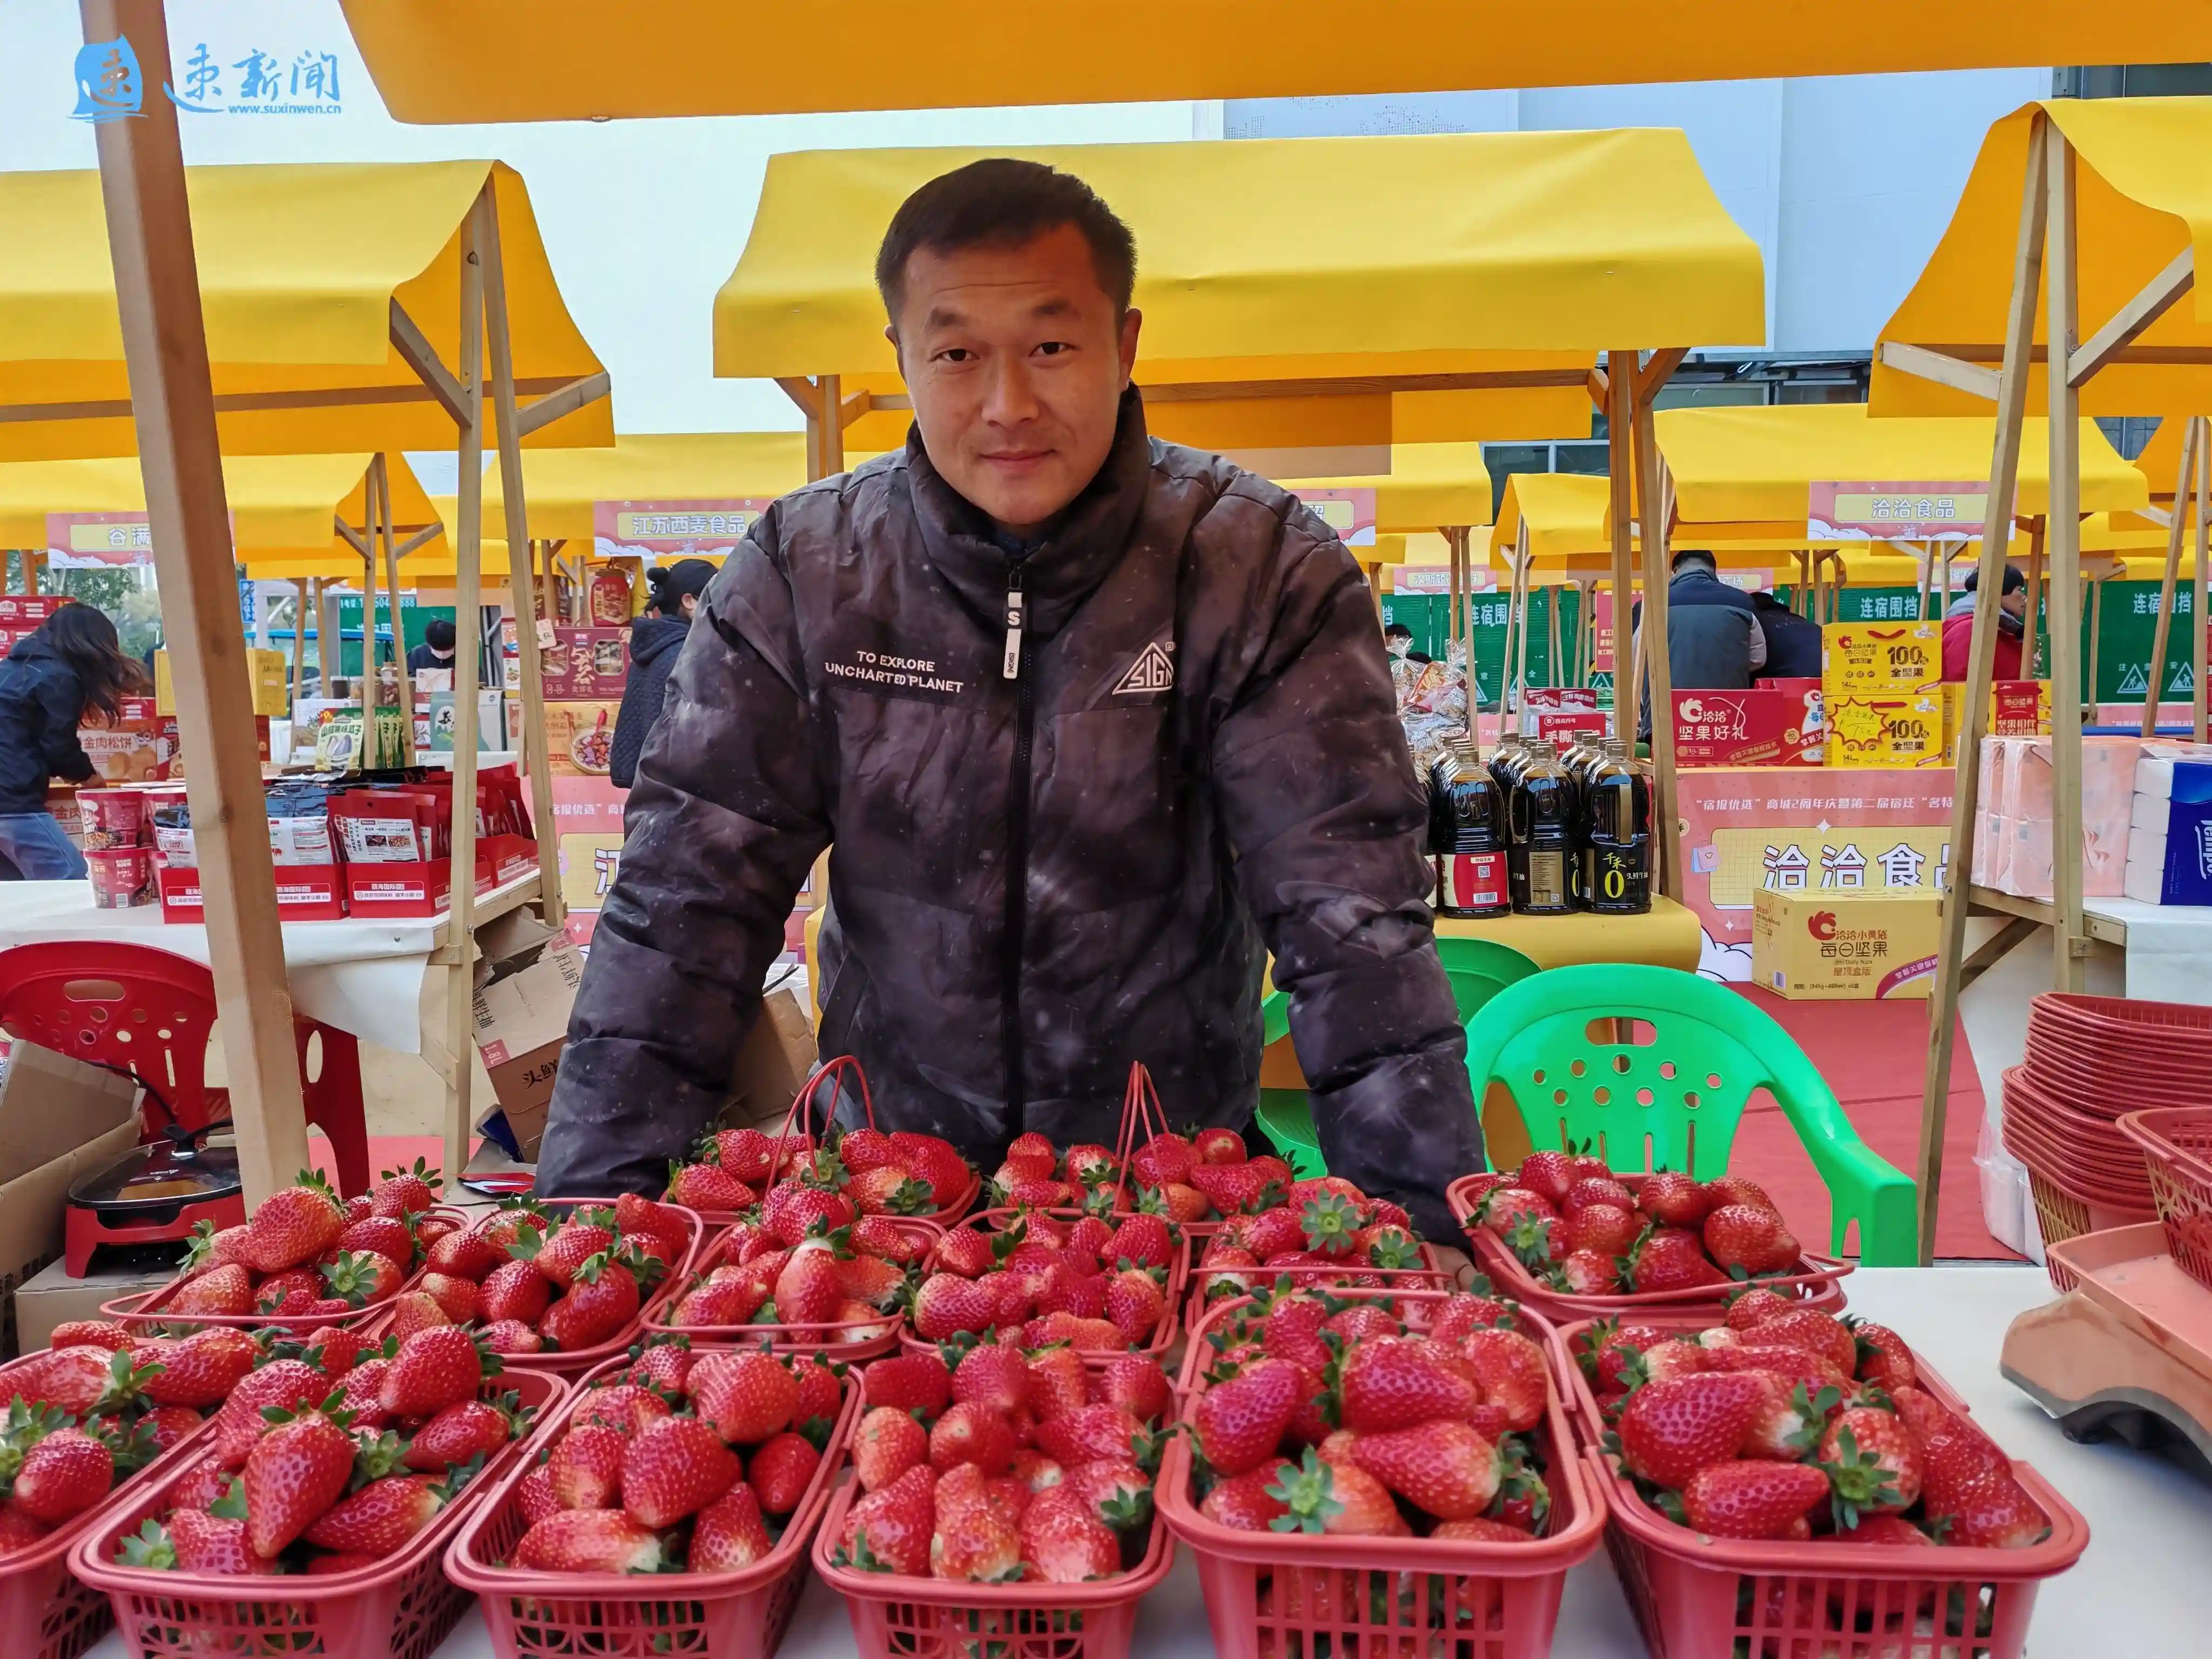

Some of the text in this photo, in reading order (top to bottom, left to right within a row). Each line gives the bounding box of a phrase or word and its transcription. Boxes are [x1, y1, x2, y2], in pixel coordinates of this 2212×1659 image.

[1871, 498, 1955, 518] 洽洽食品
[632, 515, 747, 536] 江苏西麦食品
[1860, 596, 1919, 619] 连宿围挡
[2133, 592, 2193, 615] 连宿挡
[1007, 611, 1021, 626] S
[857, 650, 936, 672] TO EXPLORE
[1887, 645, 1929, 665] 100%
[824, 662, 964, 693] UNCHARTED PLANET
[1891, 667, 1924, 678] 全坚果
[1702, 710, 1727, 723] 洽洽
[1678, 725, 1750, 741] 坚果好礼
[1888, 719, 1930, 739] 100%
[1892, 741, 1925, 751] 全坚果
[1836, 929, 1887, 941] 洽洽小黄袋
[1820, 941, 1889, 957] 每日坚果
